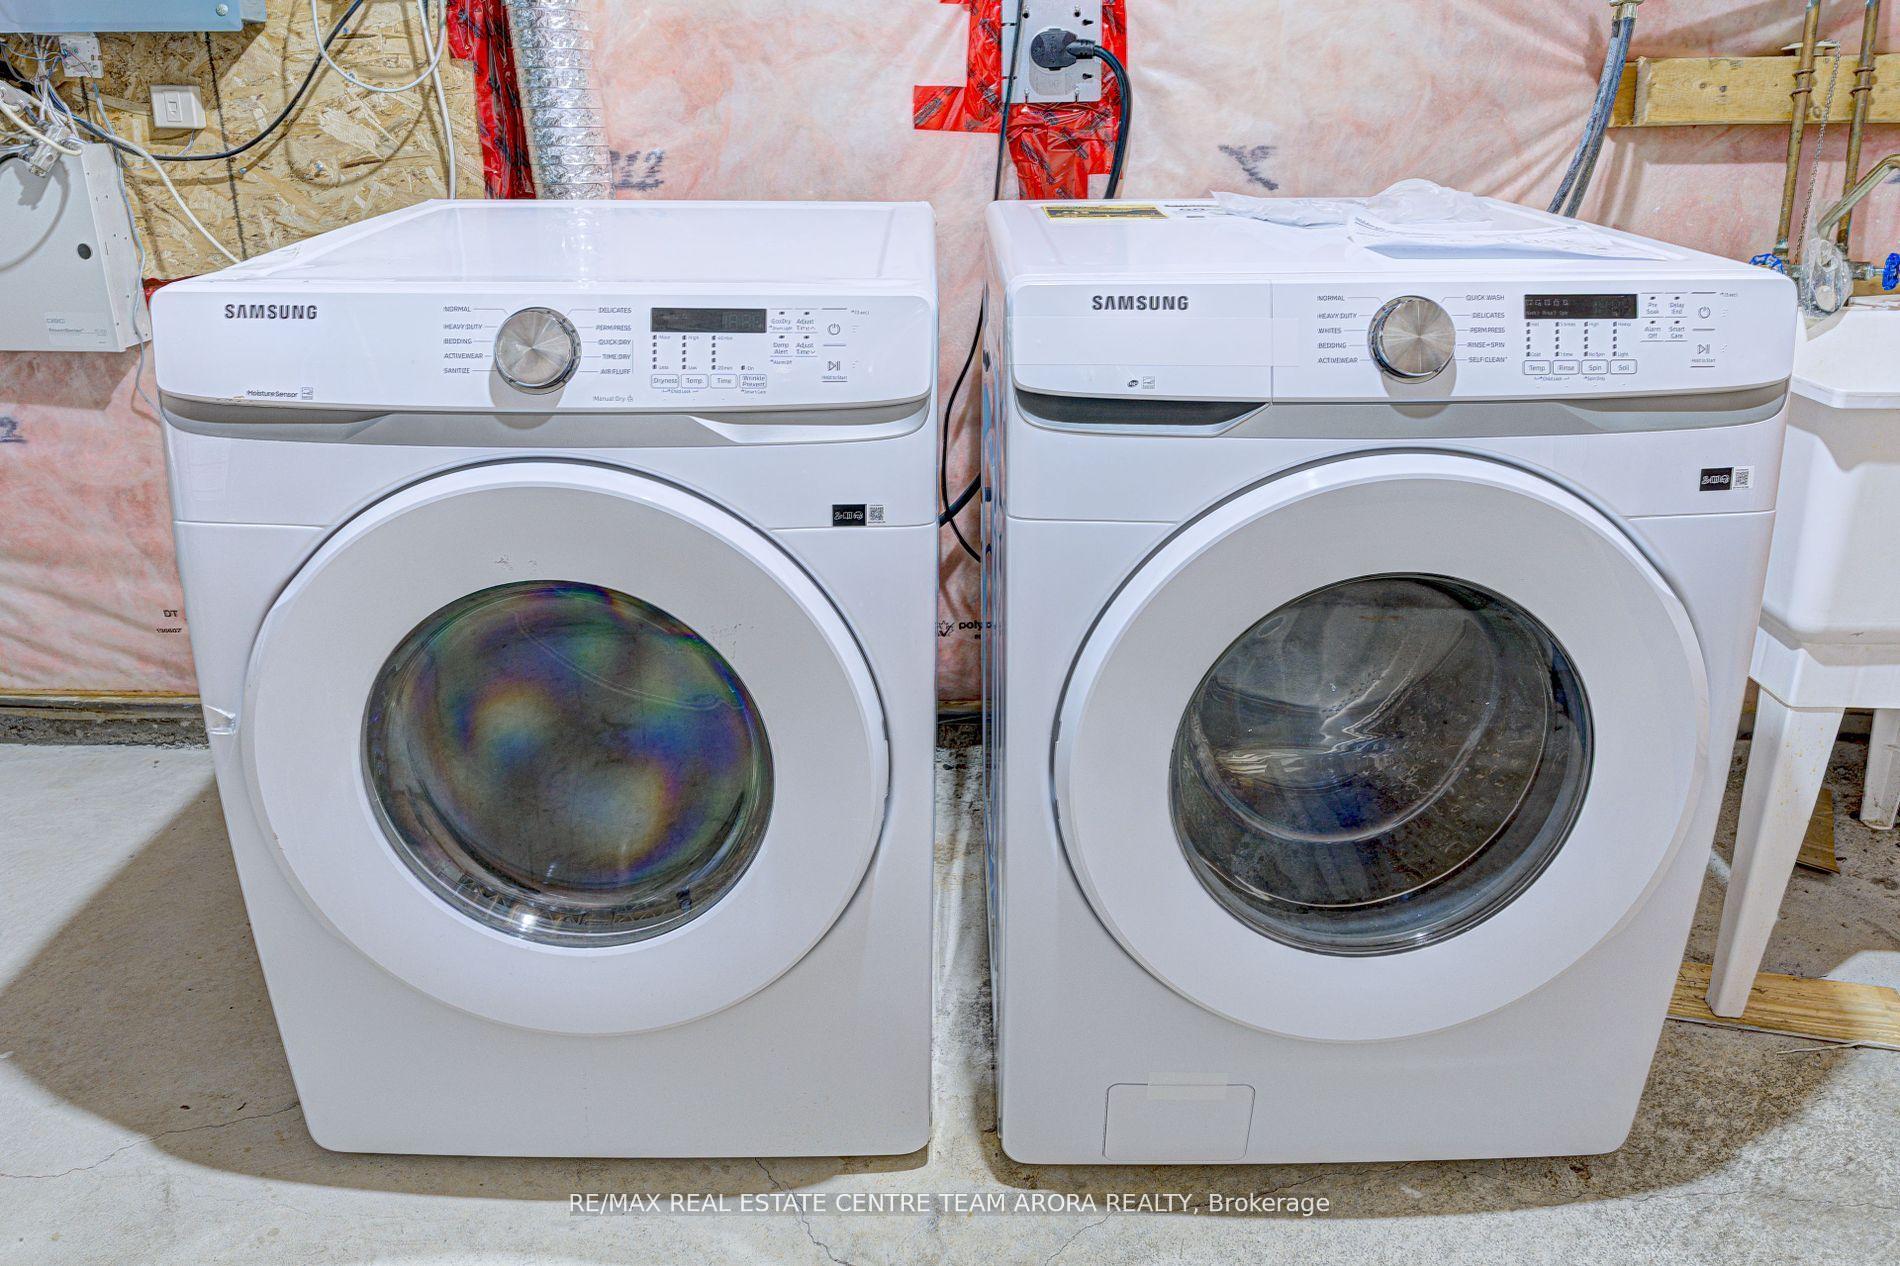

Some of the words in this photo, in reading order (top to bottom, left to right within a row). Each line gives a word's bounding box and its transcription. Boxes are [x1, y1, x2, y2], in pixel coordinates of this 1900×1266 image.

[1092, 295, 1189, 310] SAMSUNG
[224, 304, 318, 320] SAMSUNG
[443, 305, 472, 313] NORMAL
[1316, 312, 1339, 320] HEAVY
[1340, 312, 1358, 320] DUTY
[596, 324, 614, 332] PERM
[614, 324, 632, 332] PRESS
[1318, 356, 1359, 364] ACTIVEWEAR
[1588, 364, 1602, 373] Spin
[653, 377, 678, 385] Dryness
[247, 389, 275, 397] Moisture
[274, 390, 299, 398] Sensor
